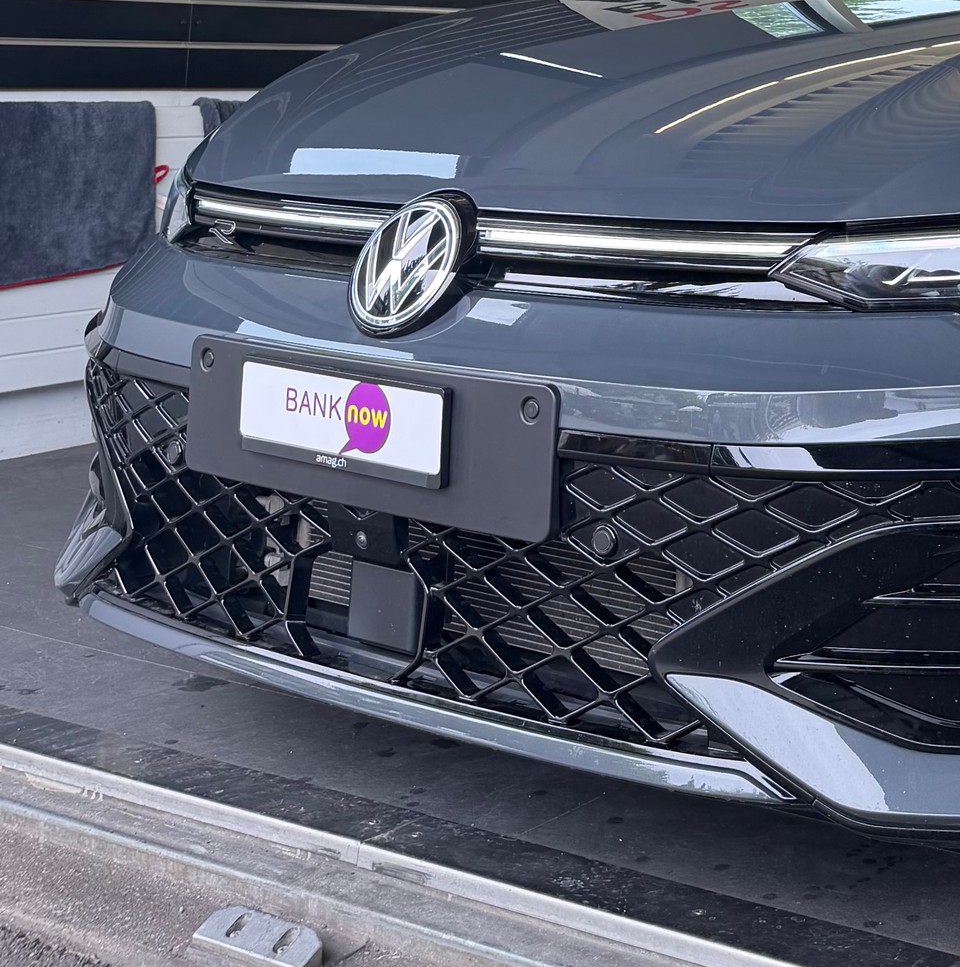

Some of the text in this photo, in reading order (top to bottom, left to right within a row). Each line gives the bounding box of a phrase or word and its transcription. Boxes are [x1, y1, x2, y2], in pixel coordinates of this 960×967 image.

[208, 219, 237, 245] R
[285, 387, 388, 429] BANK now
[315, 454, 347, 469] amag.ch
